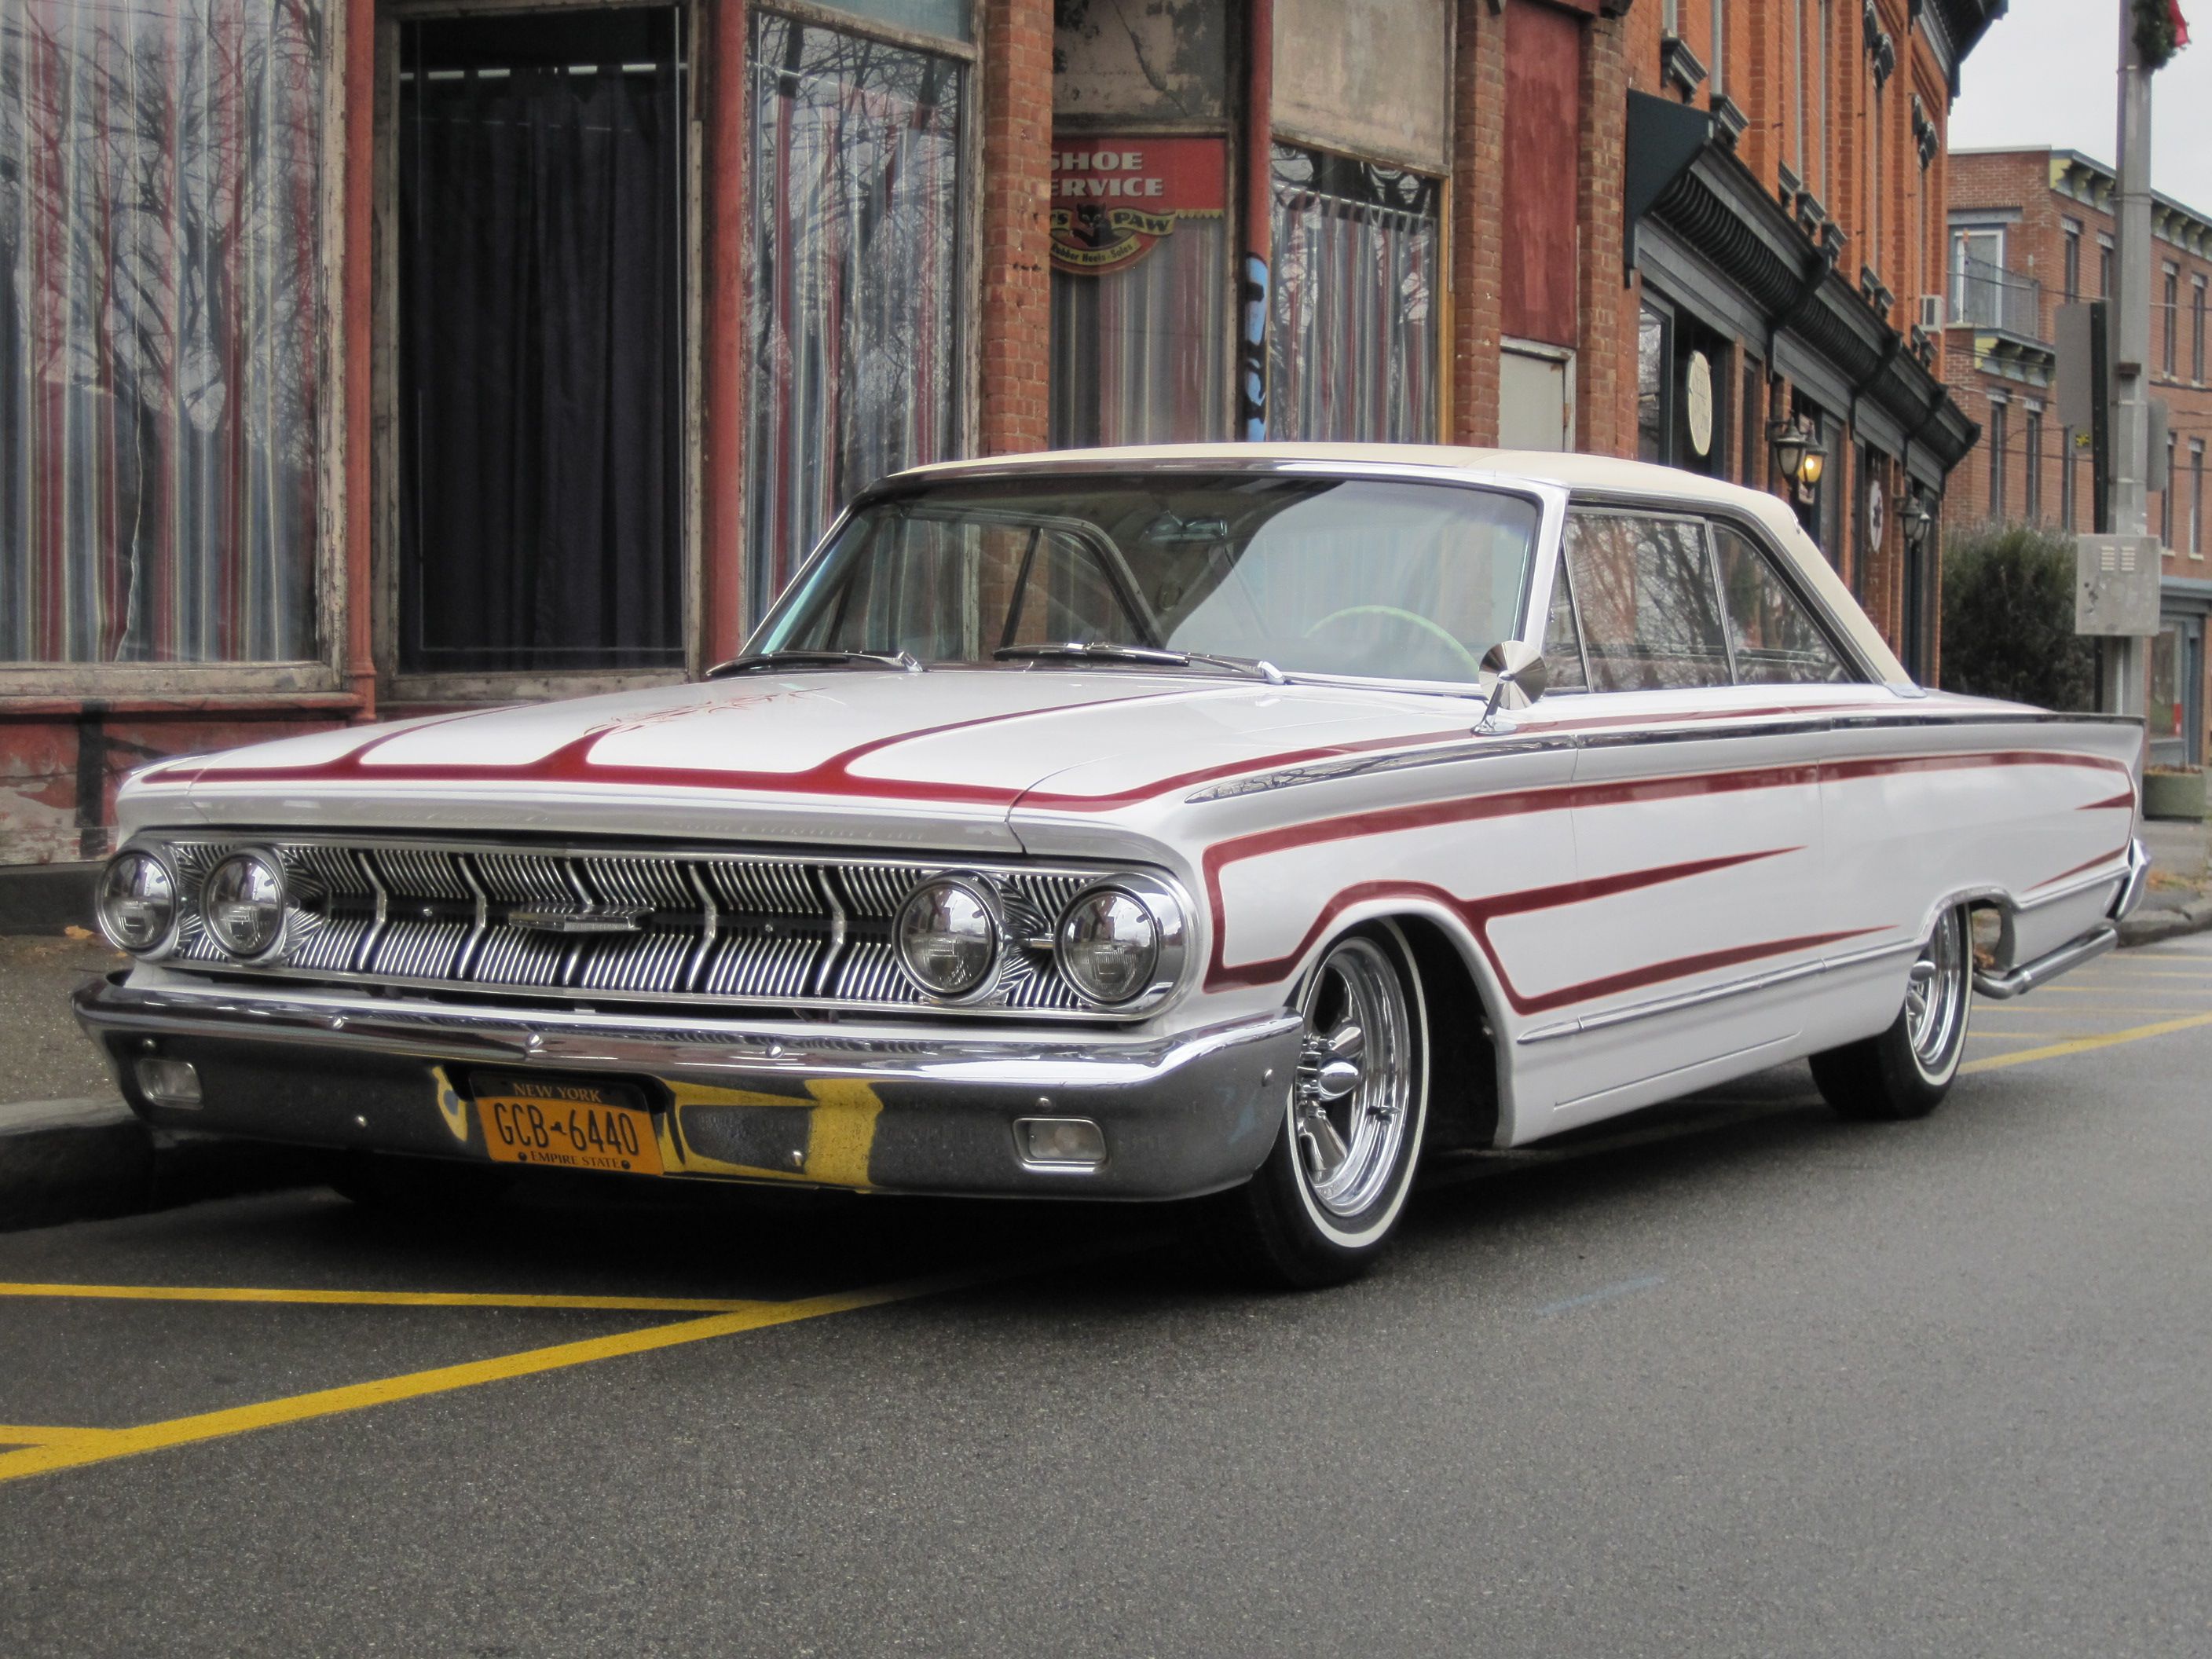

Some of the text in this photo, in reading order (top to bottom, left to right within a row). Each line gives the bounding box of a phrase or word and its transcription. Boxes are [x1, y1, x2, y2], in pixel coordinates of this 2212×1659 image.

[1113, 212, 1170, 232] PAW
[1110, 244, 1133, 258] Soles
[513, 1082, 602, 1103] NEW YORK
[529, 1150, 621, 1169] EMPIRE STATE
